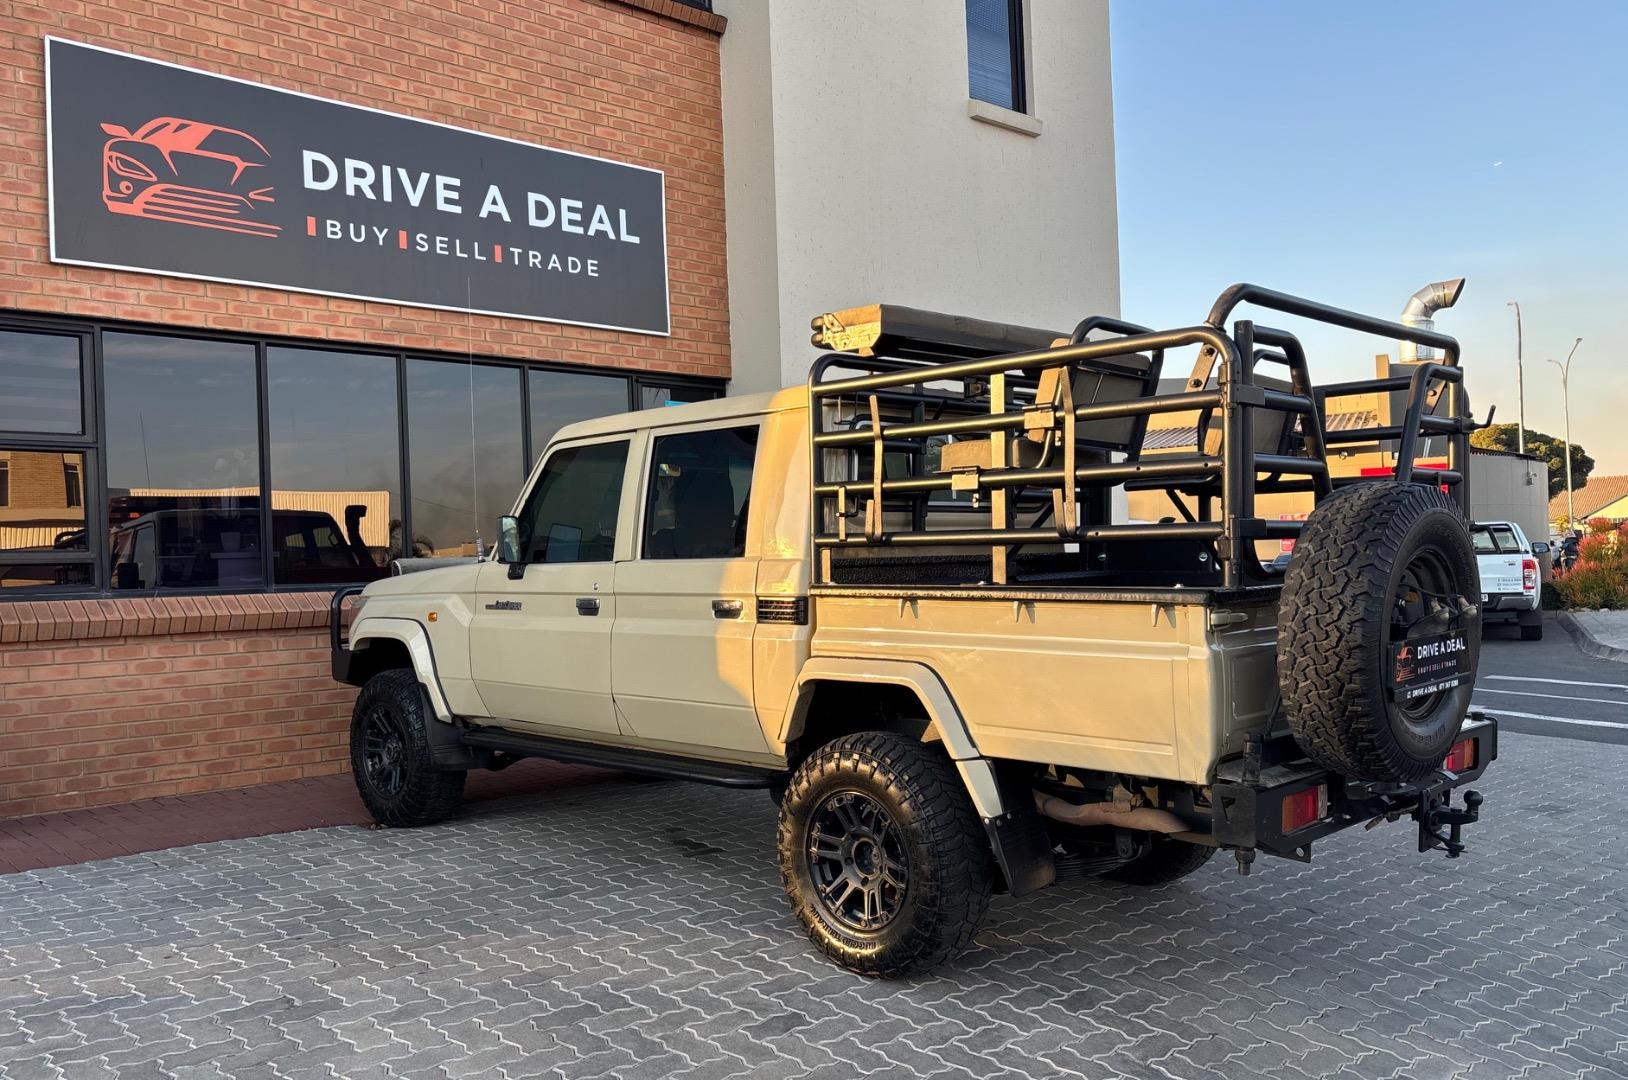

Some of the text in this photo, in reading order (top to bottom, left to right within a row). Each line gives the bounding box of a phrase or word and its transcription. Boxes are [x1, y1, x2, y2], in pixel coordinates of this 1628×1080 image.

[302, 149, 641, 245] DRIVE A DEAL
[325, 219, 599, 277] BUY SELL TRADE
[1417, 637, 1465, 659] DRIVE A DEAL
